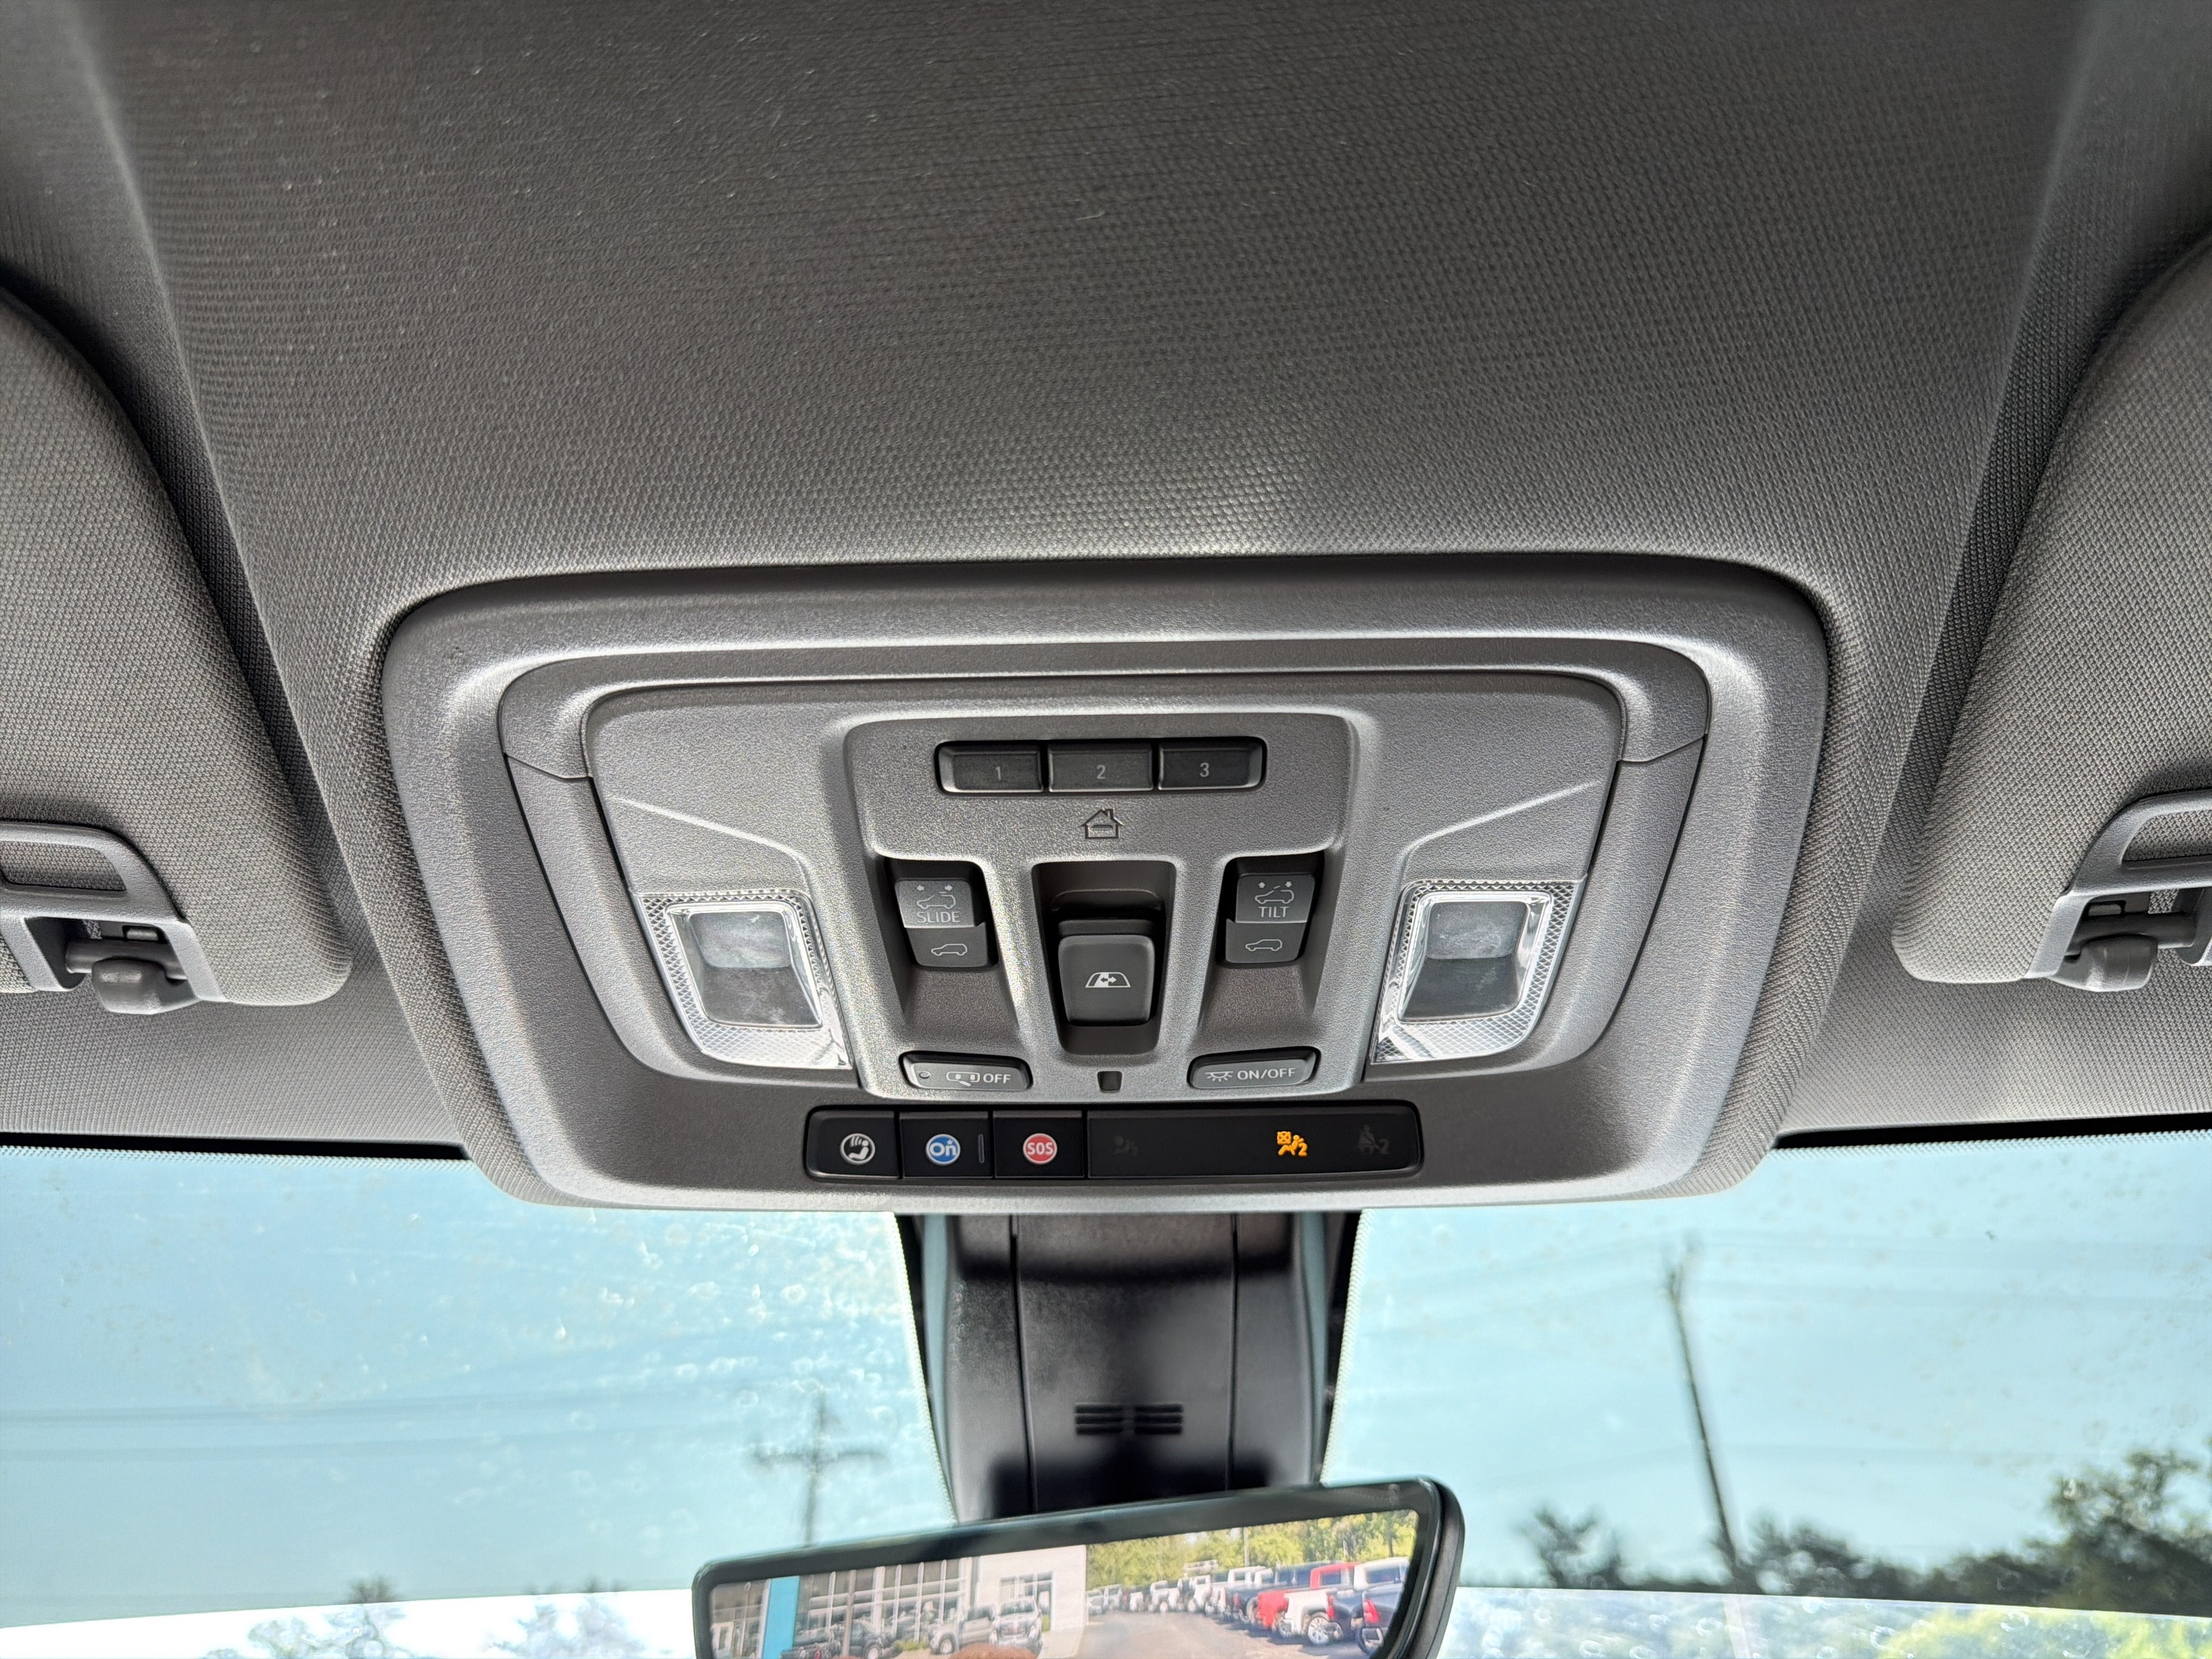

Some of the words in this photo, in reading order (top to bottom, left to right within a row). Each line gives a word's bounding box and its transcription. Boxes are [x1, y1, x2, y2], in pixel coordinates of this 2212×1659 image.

[995, 766, 1001, 780] 1
[1097, 765, 1105, 779] 2
[1199, 763, 1209, 777] 3
[916, 911, 960, 923] SLIDE
[1258, 906, 1290, 918] TILT
[983, 1073, 1011, 1084] OFF
[1237, 1068, 1296, 1080] ON/OFF
[930, 1141, 957, 1156] On
[1027, 1142, 1053, 1155] SOS
[1298, 1143, 1308, 1156] 2
